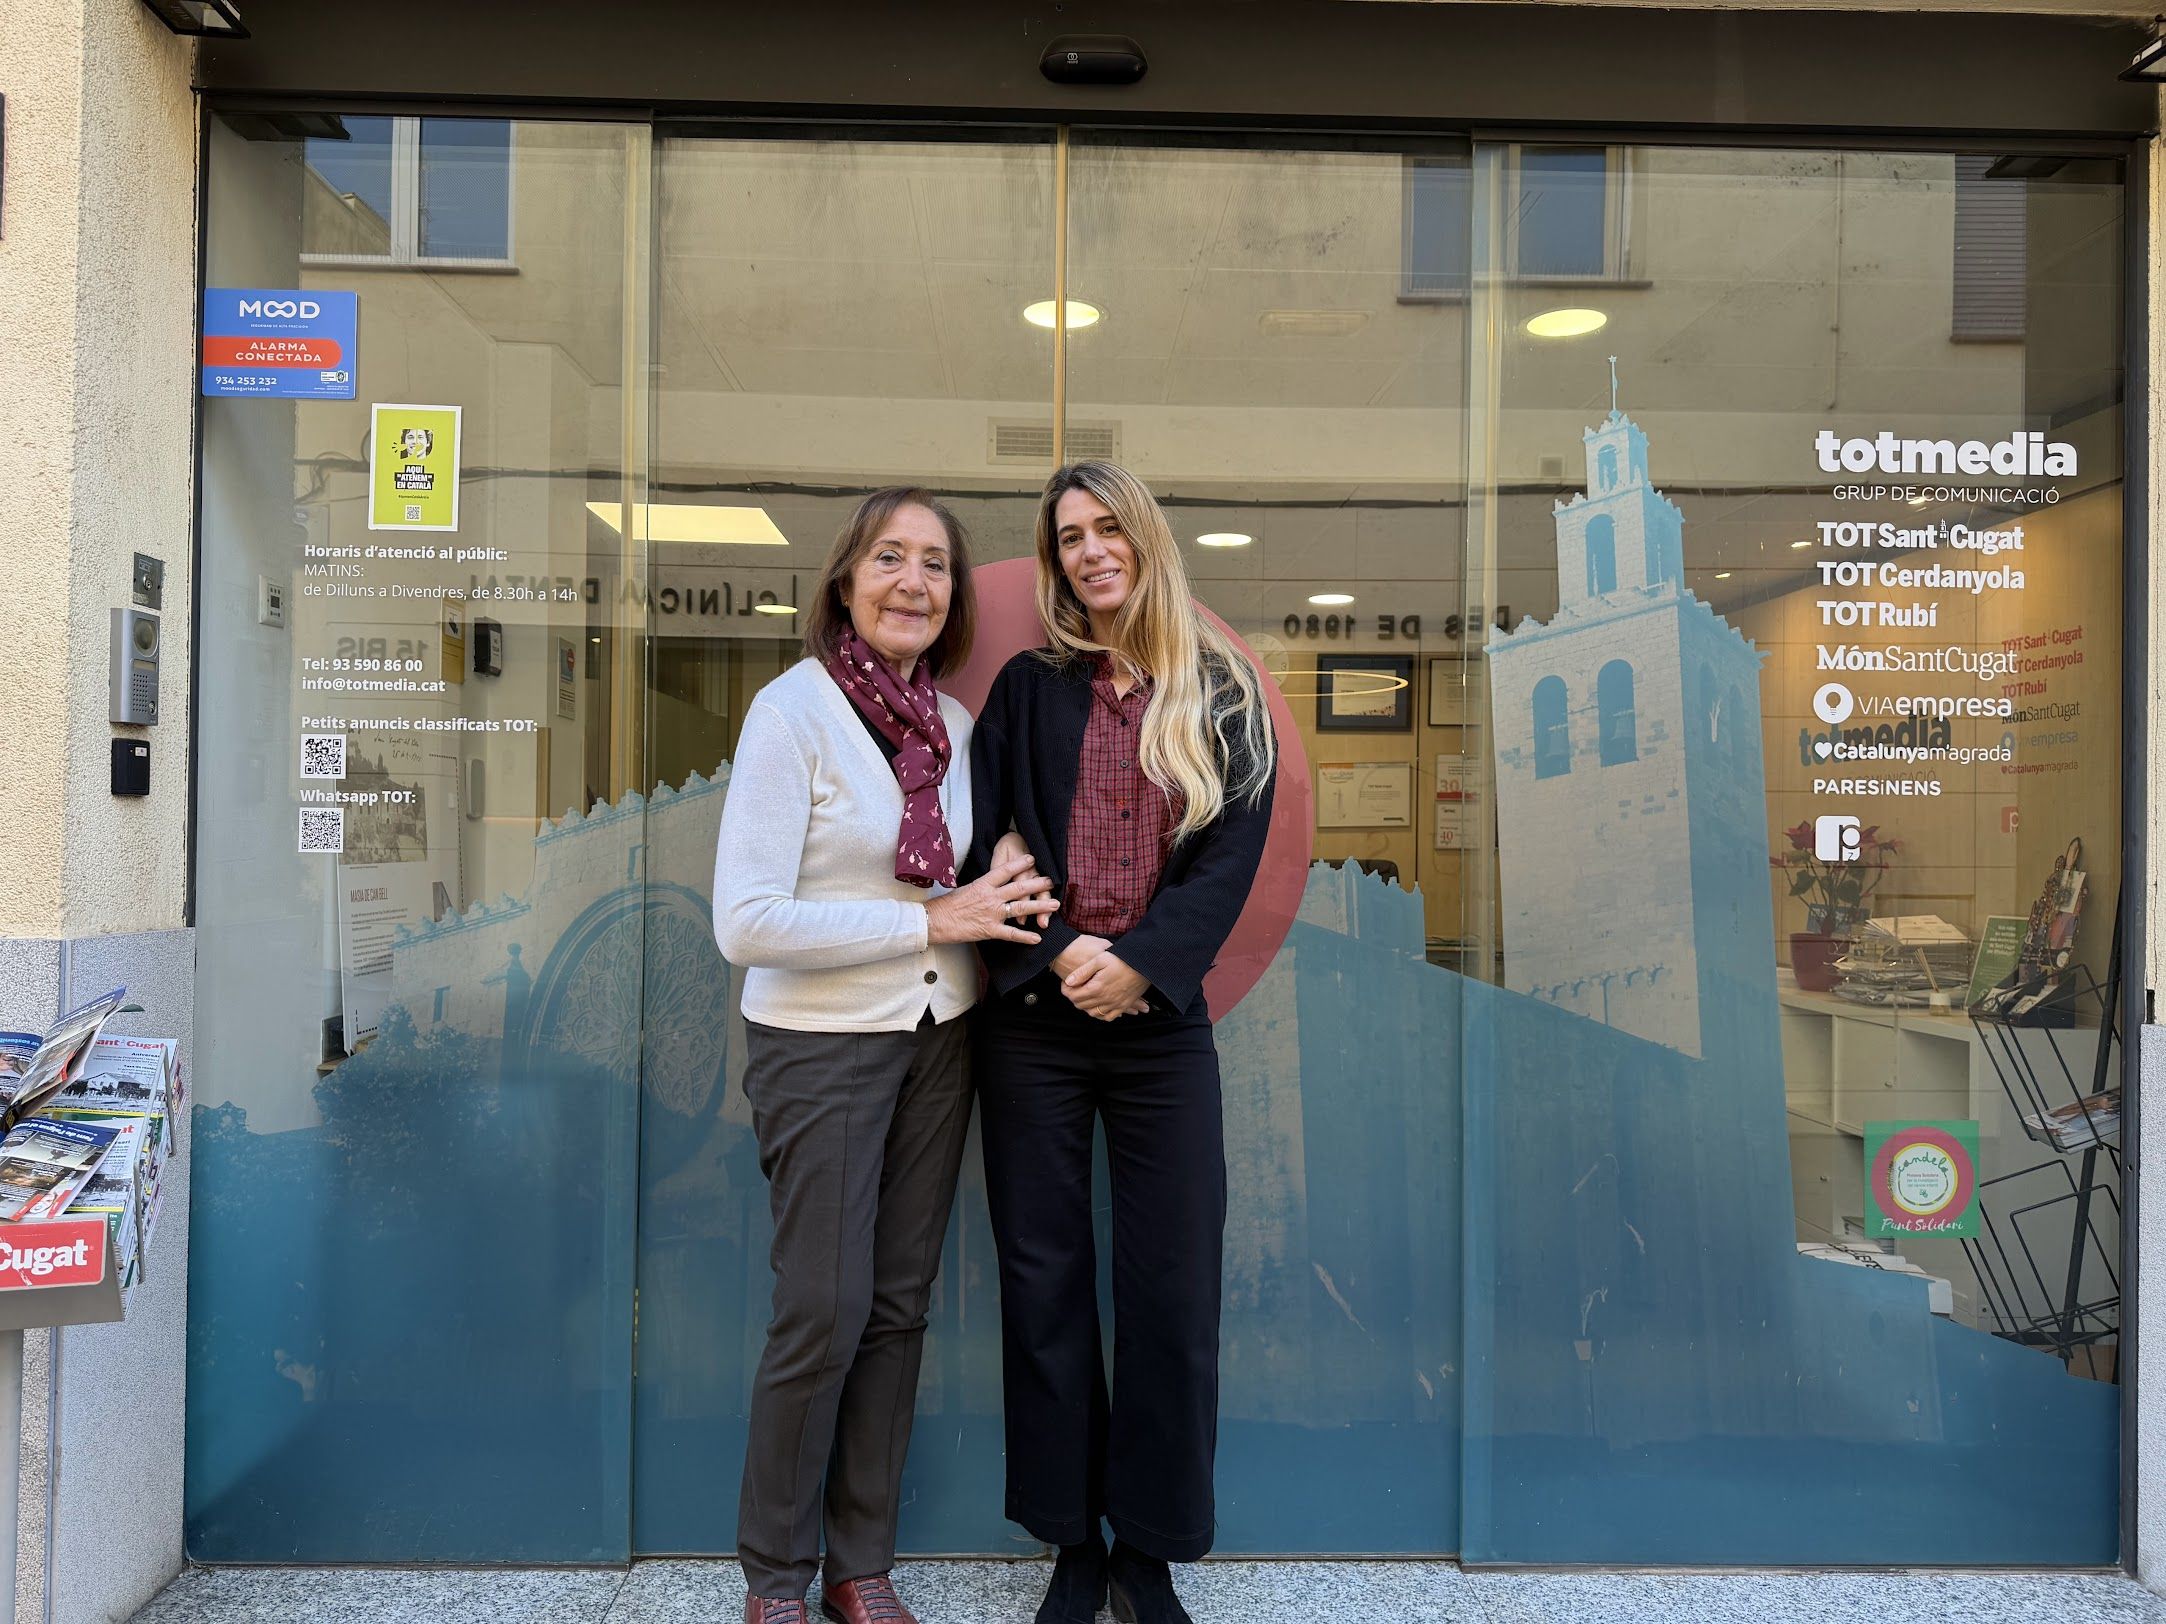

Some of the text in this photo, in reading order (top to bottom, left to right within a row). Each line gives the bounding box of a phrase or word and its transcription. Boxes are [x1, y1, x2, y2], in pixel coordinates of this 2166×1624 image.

[239, 299, 321, 319] MOOD
[250, 342, 307, 351] ALARMA
[235, 352, 322, 362] CONECTADA
[215, 376, 277, 385] 934 253 232
[1815, 430, 2078, 476] totmedia
[406, 465, 423, 474] AQUÍ
[396, 480, 432, 489] EN CATALÀ
[1833, 485, 2060, 504] GRUP DE COMUNICACIÓ
[1817, 522, 2024, 555] TOT Sant Cugat
[304, 544, 361, 558] Horaris
[439, 547, 453, 559] al
[457, 546, 508, 563] públic:
[304, 564, 365, 577] MATINS:
[1817, 561, 2025, 594] TOT Cerdanyola
[303, 583, 577, 601] de Dilluns a Divendres, de 8.30h a 14h
[1817, 601, 1939, 628] TOT Rubí
[2024, 632, 2047, 650] Sant
[2052, 625, 2083, 645] Cugat
[302, 657, 423, 672] Tel: 93 590 86 00
[1816, 645, 2018, 681] MónSantCugat
[2024, 650, 2083, 673] Cerdanyola
[301, 677, 446, 692] info@totmedia.cat
[2002, 678, 2047, 698] TOT Rubí
[1858, 695, 2013, 722] VIAempresa
[301, 716, 538, 732] Petits anuncis classificats TOT:
[300, 790, 416, 806] Whatsapp TOT:
[126, 1040, 164, 1050] Cugat
[1880, 1218, 1964, 1232] Punt Solidari
